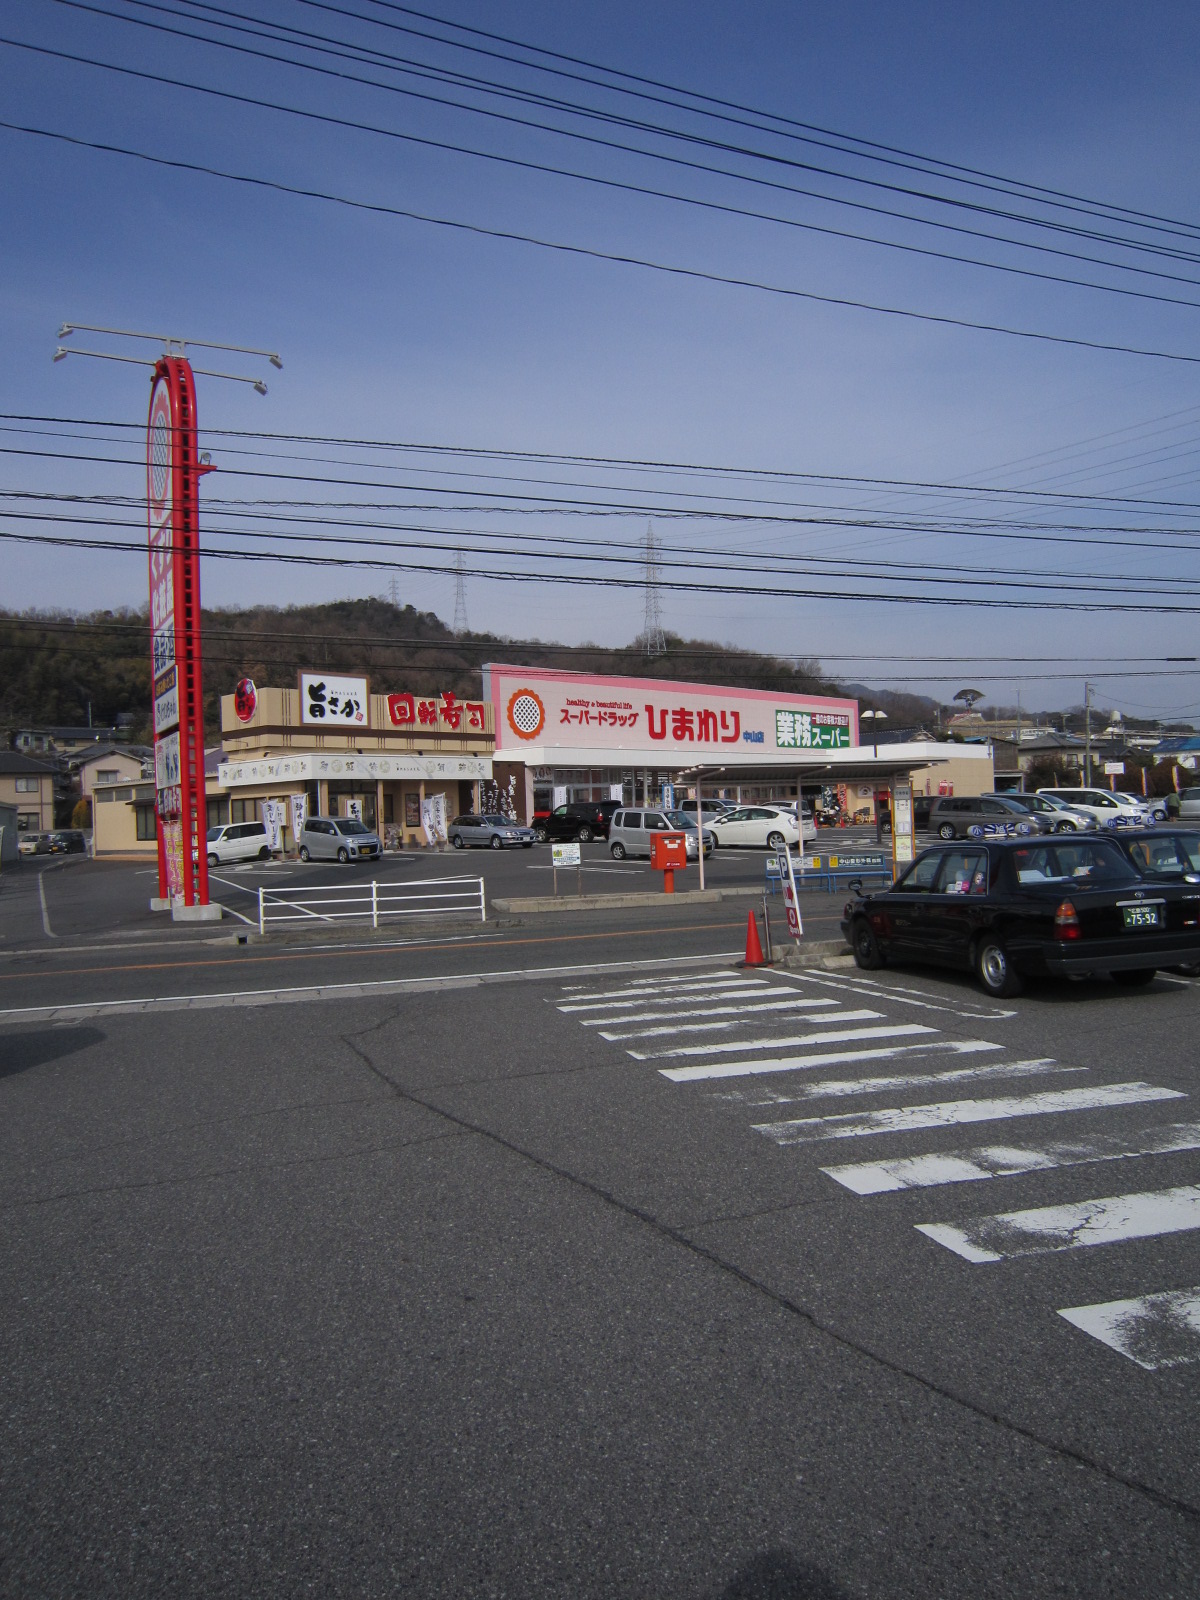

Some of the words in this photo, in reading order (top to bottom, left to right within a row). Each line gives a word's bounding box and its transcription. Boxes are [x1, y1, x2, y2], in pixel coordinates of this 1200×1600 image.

[308, 682, 360, 718] 旨さか
[566, 698, 590, 708] healthy
[596, 701, 622, 709] beautiful
[623, 702, 632, 710] life
[387, 691, 484, 730] 回転寿司
[560, 709, 639, 727] スーパードラッグ
[645, 704, 740, 743] ひまわり
[743, 730, 764, 743] 中山店
[780, 857, 787, 877] P
[1131, 913, 1157, 925] 75-92
